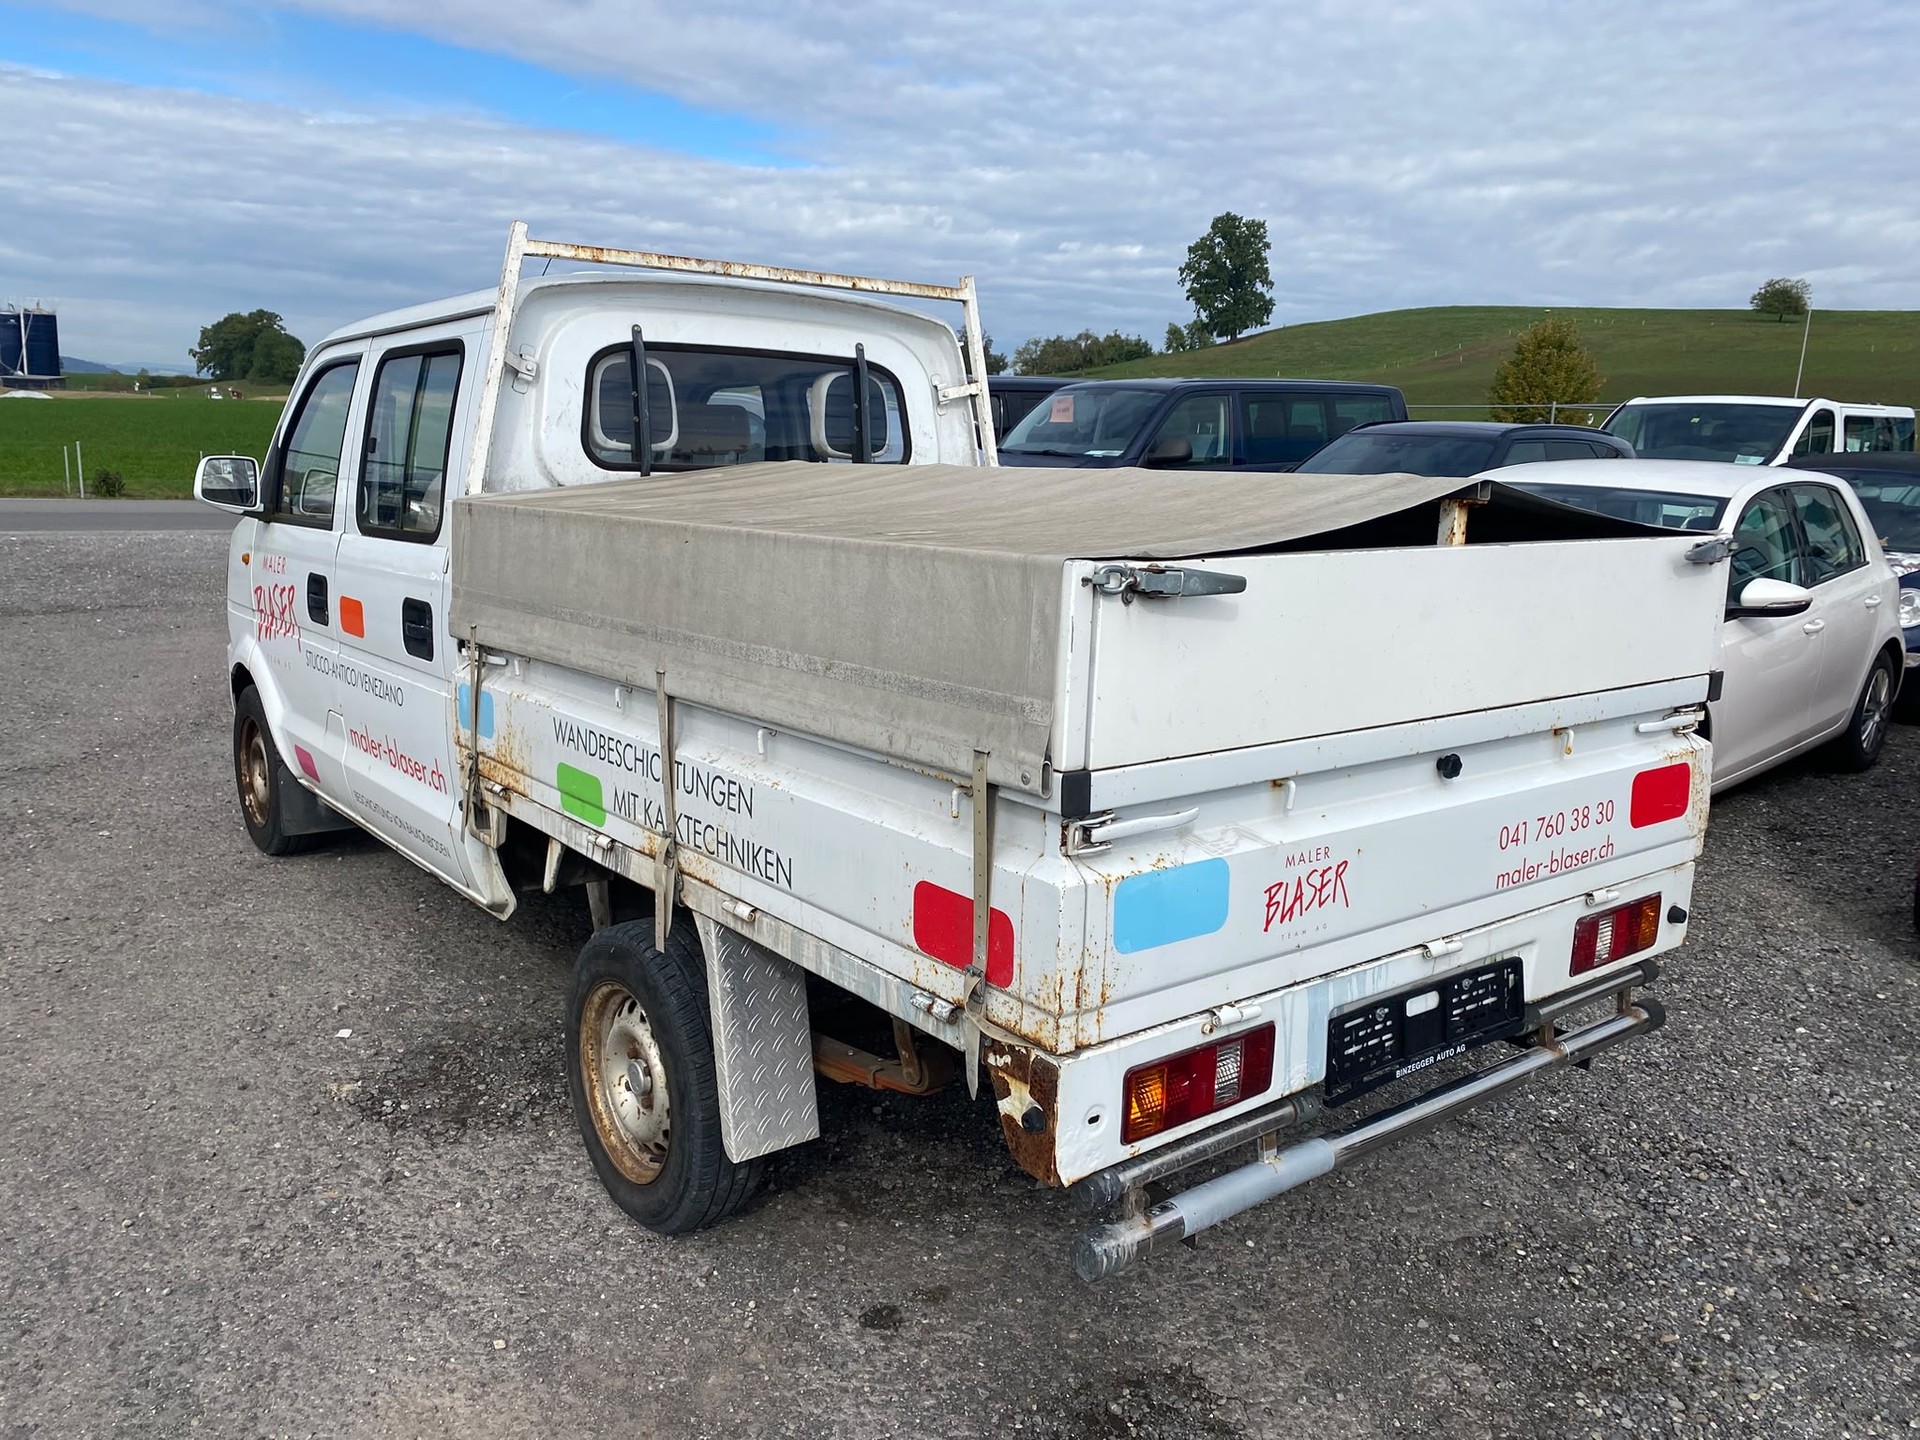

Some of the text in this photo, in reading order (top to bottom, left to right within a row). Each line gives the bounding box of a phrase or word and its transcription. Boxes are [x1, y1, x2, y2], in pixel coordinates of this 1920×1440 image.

[262, 554, 287, 575] MALER
[349, 725, 448, 795] maler-blaser.ch
[553, 717, 754, 819] WANDBESCHICTUNGEN
[613, 786, 793, 890] MIT KAKTECHNIKEN
[1499, 799, 1615, 850] 041 760 38 30
[1285, 846, 1331, 869] MALER
[1496, 834, 1615, 890] maler-blaser.ch
[1263, 860, 1350, 933] BLASER
[1395, 1043, 1466, 1079] BINZEGGER AUTO AG
